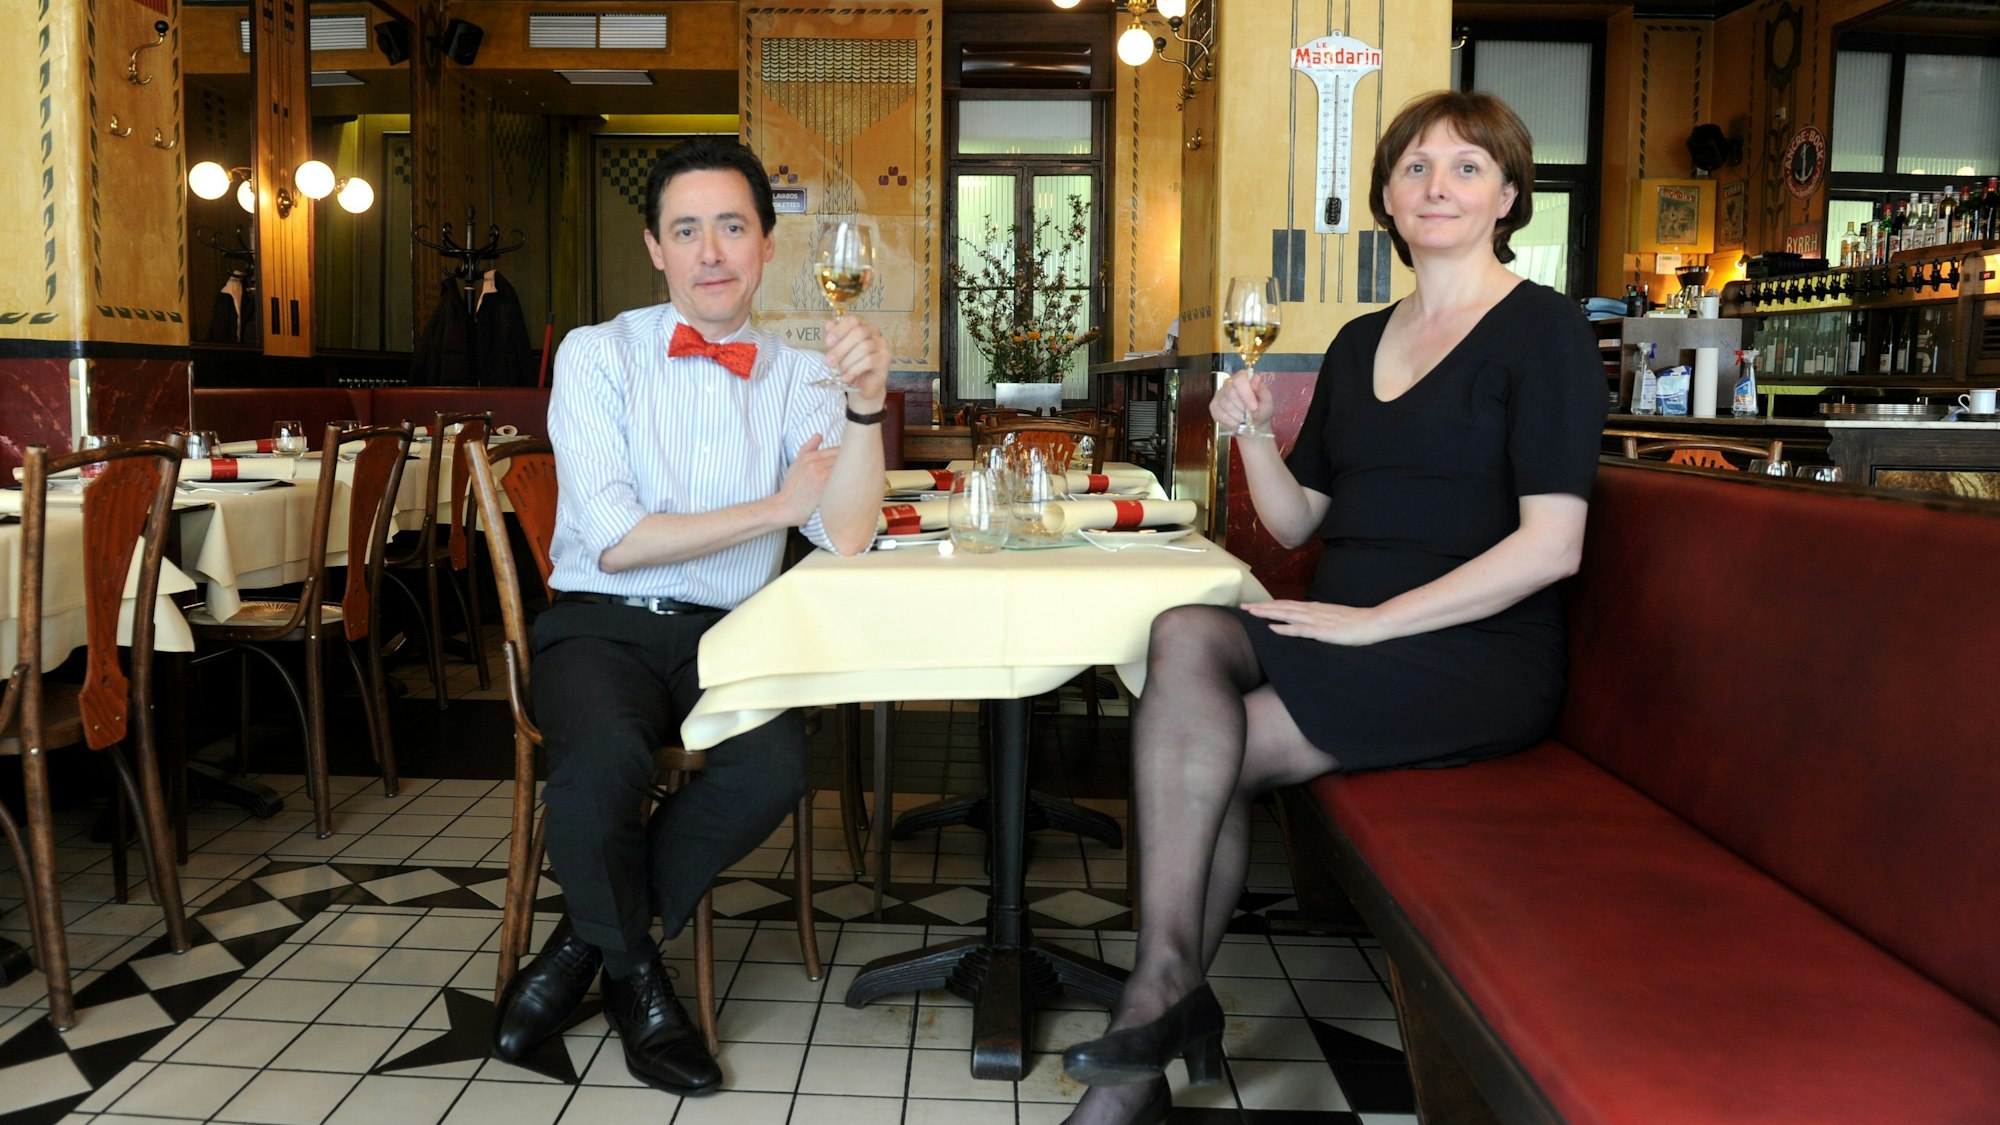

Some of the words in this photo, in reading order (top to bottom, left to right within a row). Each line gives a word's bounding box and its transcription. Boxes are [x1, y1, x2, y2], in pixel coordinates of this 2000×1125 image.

[1294, 48, 1380, 68] Mandarin
[1785, 131, 1806, 169] ANCRE
[1808, 129, 1824, 160] BOCK
[1786, 233, 1818, 254] BYRRH
